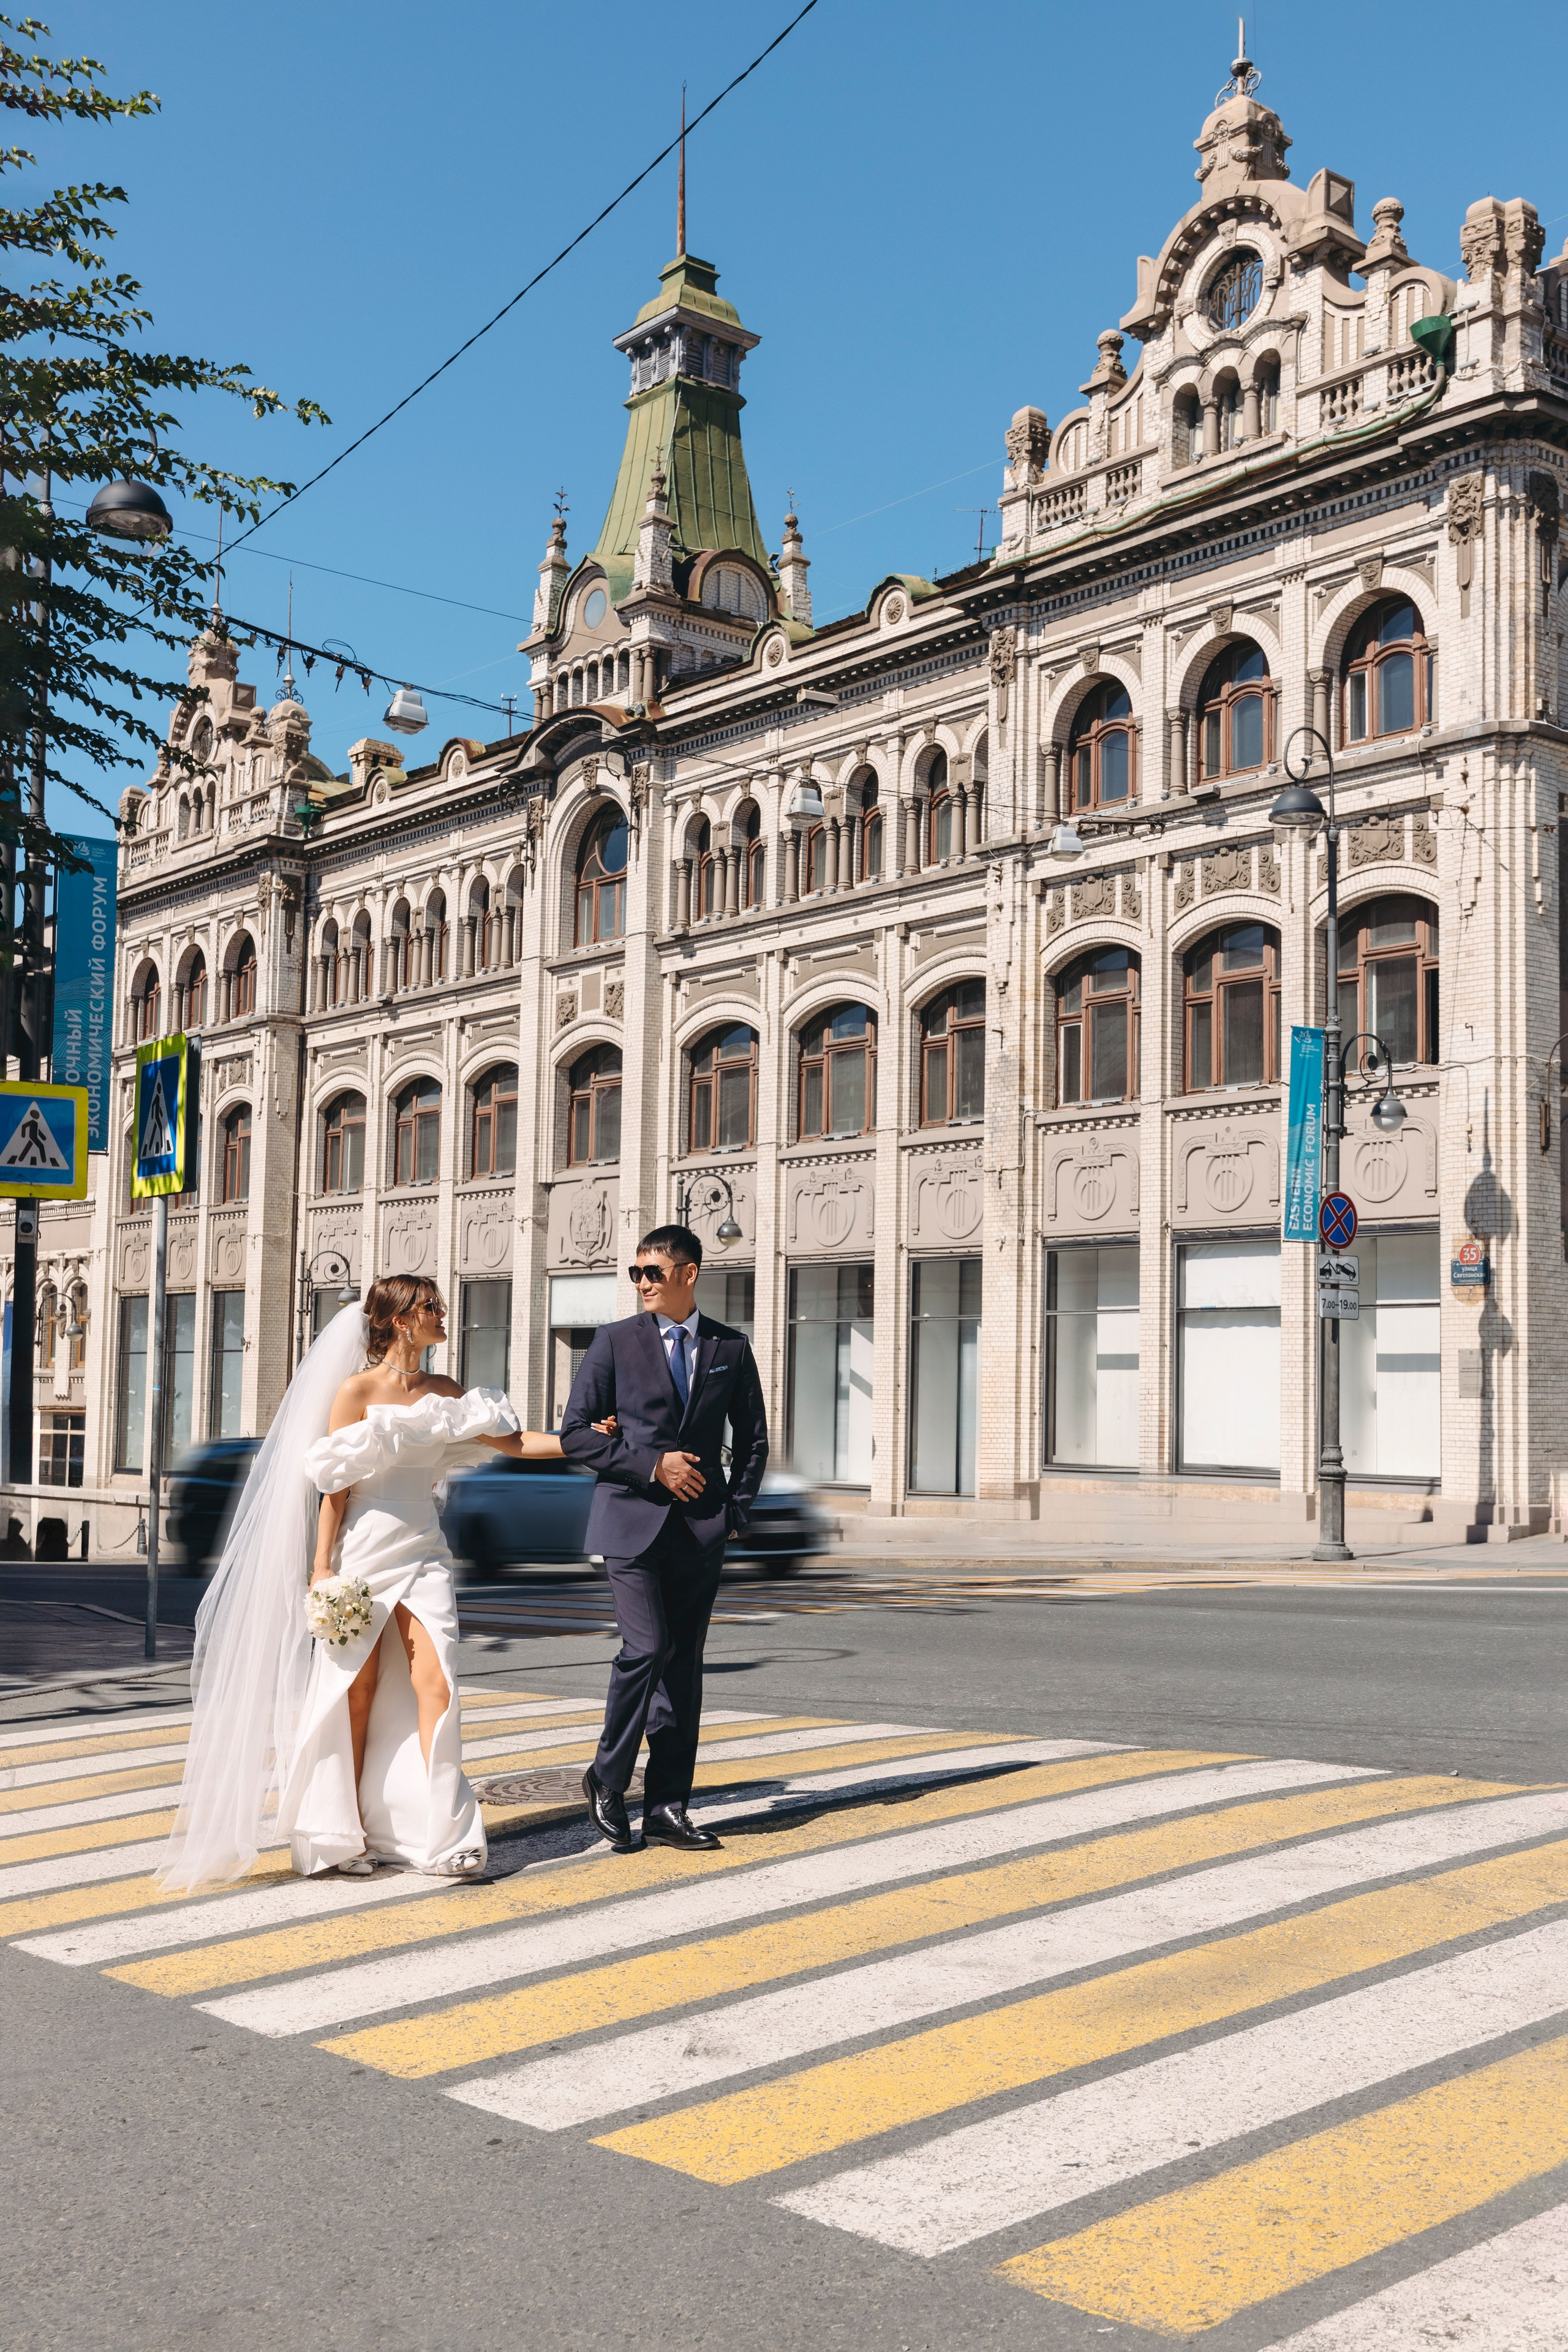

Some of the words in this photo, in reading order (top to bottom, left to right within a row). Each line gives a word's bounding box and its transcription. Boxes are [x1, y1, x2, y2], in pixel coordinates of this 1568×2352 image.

[91, 876, 108, 951] ФОРУМ
[64, 1009, 83, 1085] ОЧНЫЙ
[87, 957, 105, 1139] ЭКОНОМИЧЕСКИЙ
[1305, 1103, 1316, 1153] FORUM
[1290, 1168, 1301, 1231] EASTERN
[1303, 1158, 1315, 1231] ECONOMIC
[1463, 1247, 1477, 1261] 35
